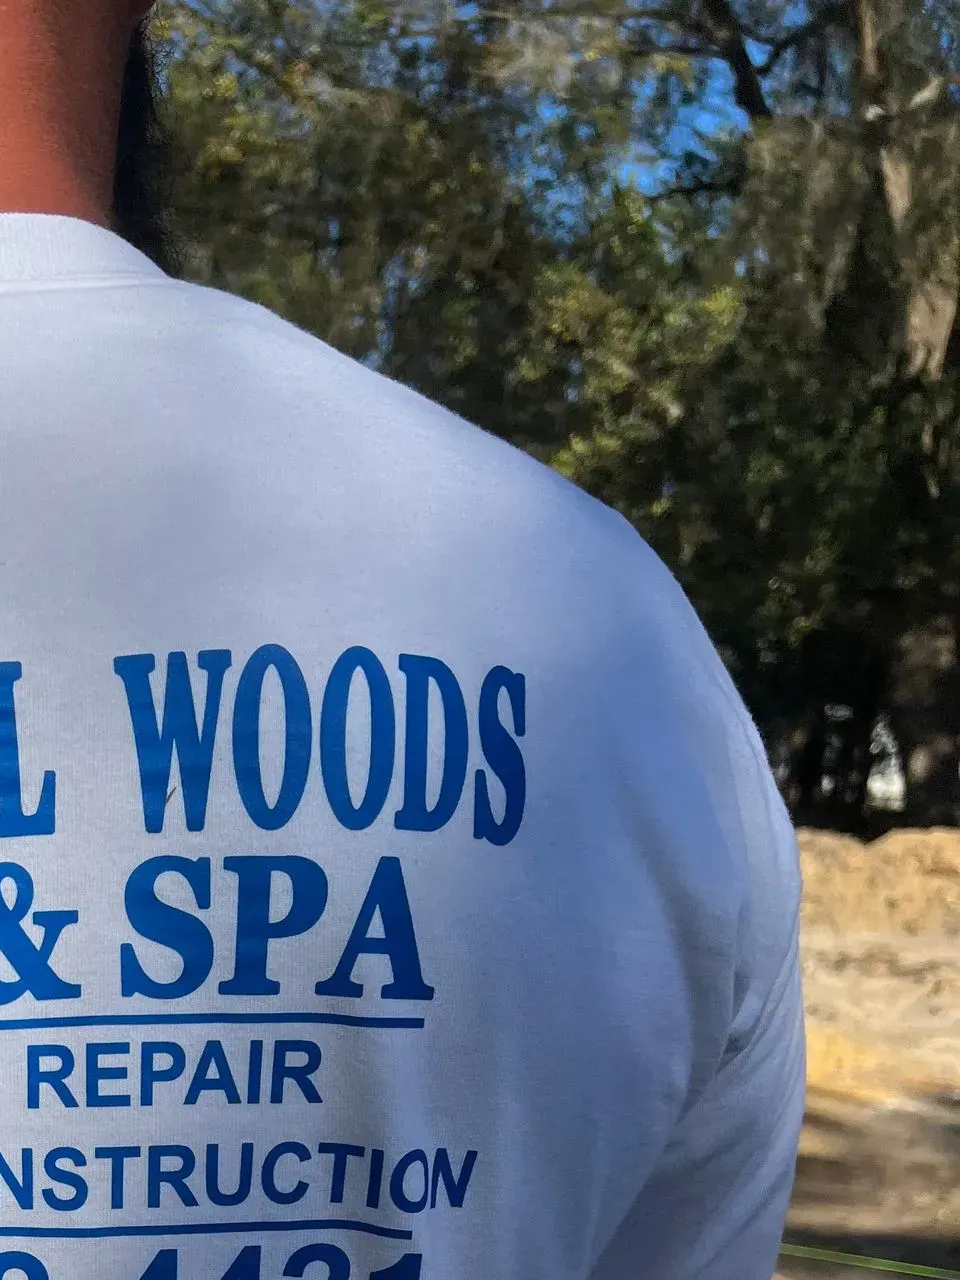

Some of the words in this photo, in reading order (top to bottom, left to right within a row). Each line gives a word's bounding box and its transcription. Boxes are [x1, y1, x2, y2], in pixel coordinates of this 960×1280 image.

[113, 644, 528, 845] WOODS
[120, 855, 434, 1000] SPA
[27, 1040, 323, 1109] REPAIR
